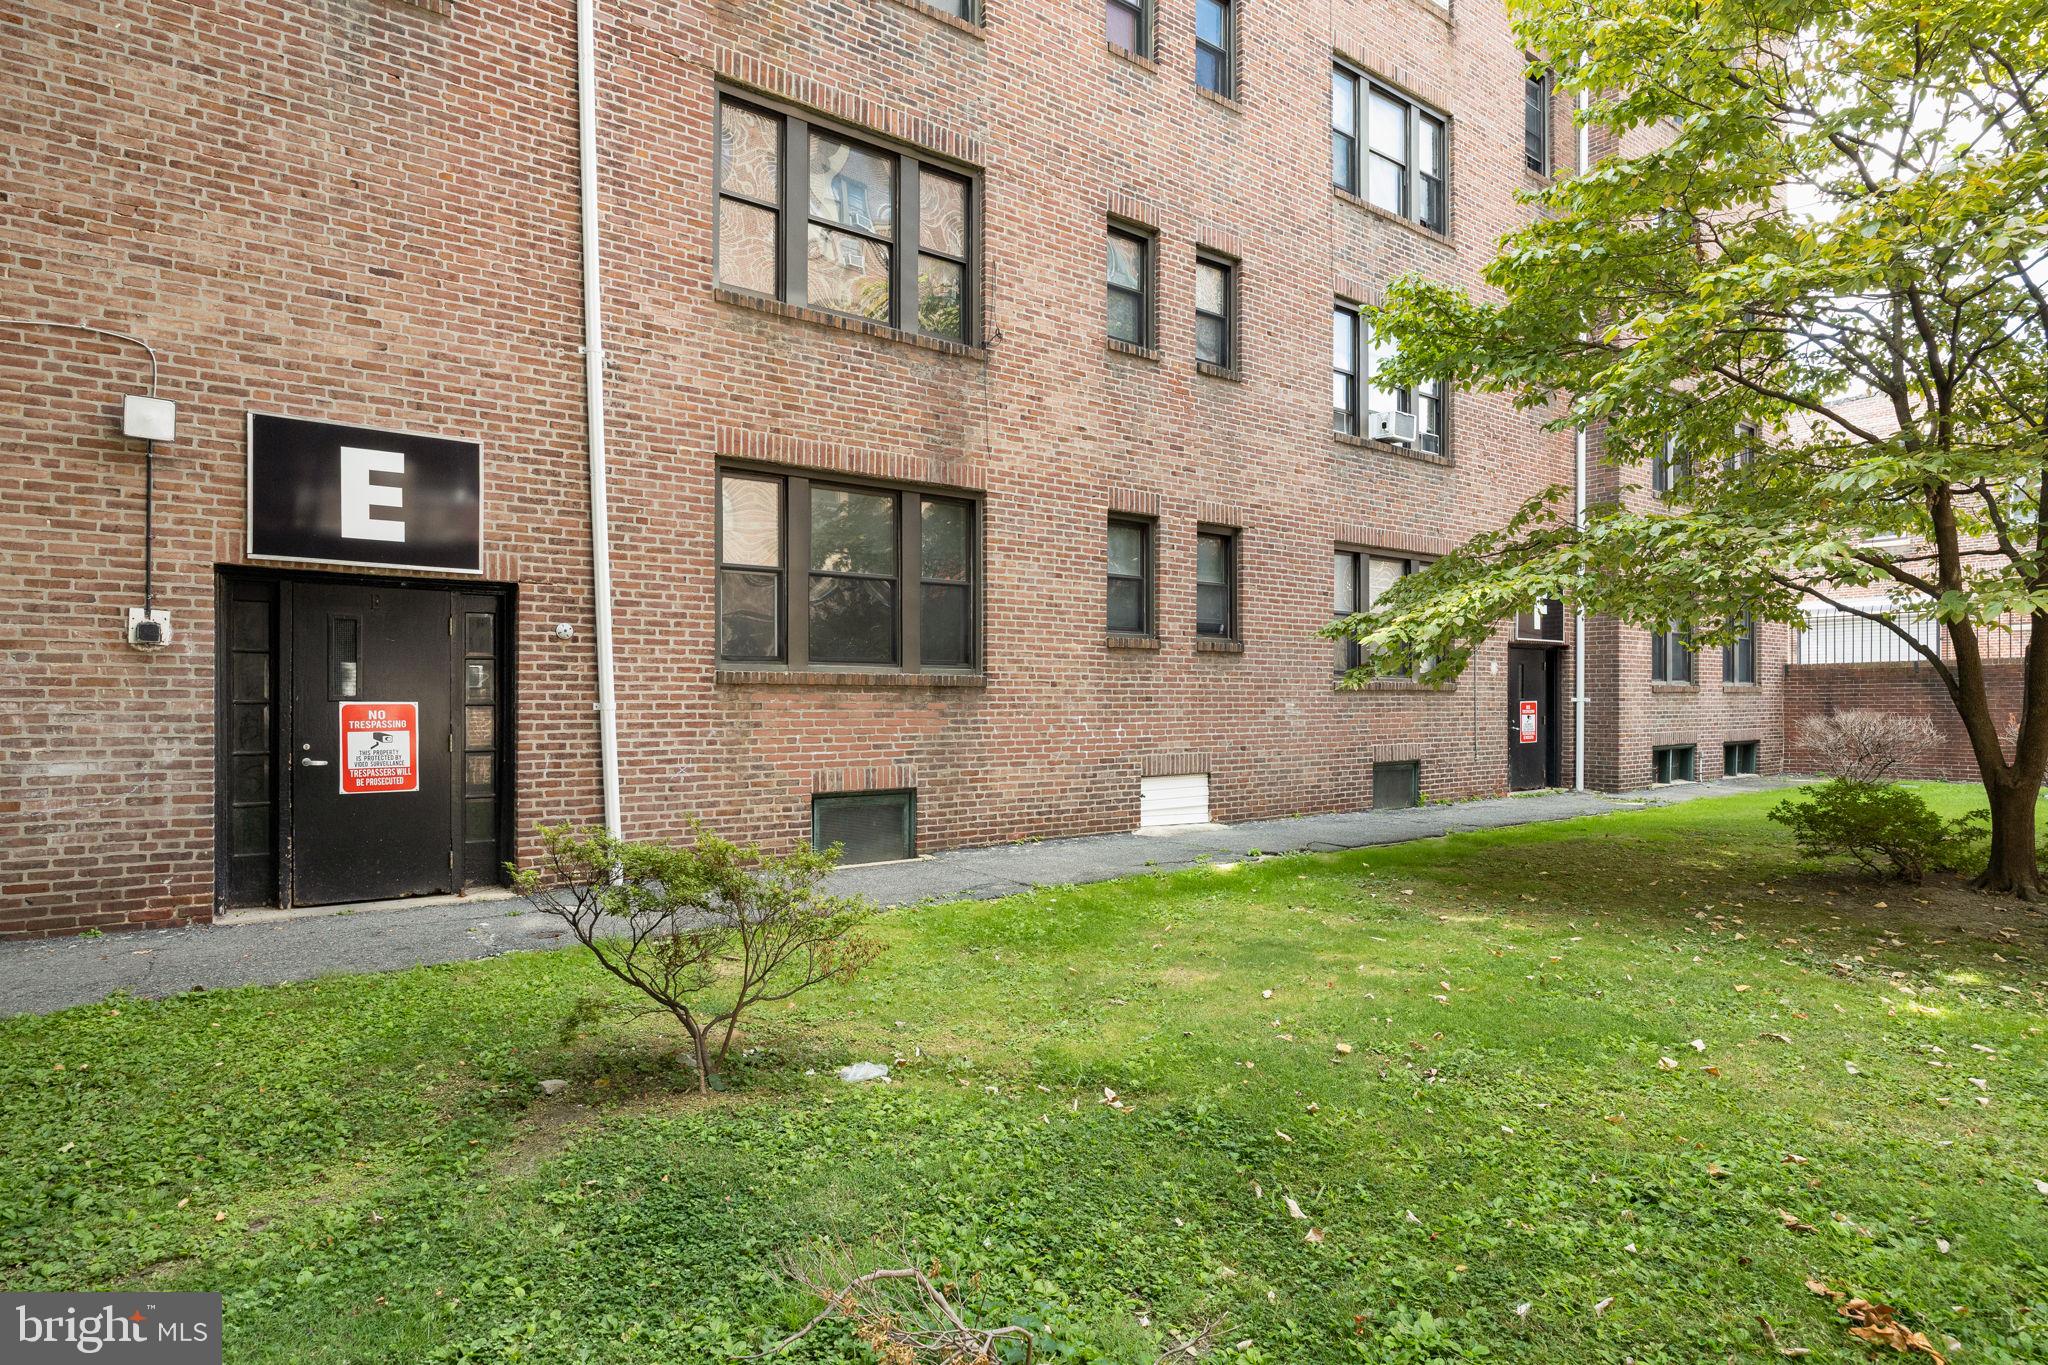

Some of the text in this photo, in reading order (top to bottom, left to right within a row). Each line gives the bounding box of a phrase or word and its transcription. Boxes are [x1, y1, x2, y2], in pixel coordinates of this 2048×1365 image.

[341, 446, 405, 542] E
[368, 710, 386, 720] NO
[348, 720, 407, 729] TRESPASSING
[349, 768, 412, 777] TRESPASSERS WILL
[356, 777, 404, 786] BE PROSECUTED
